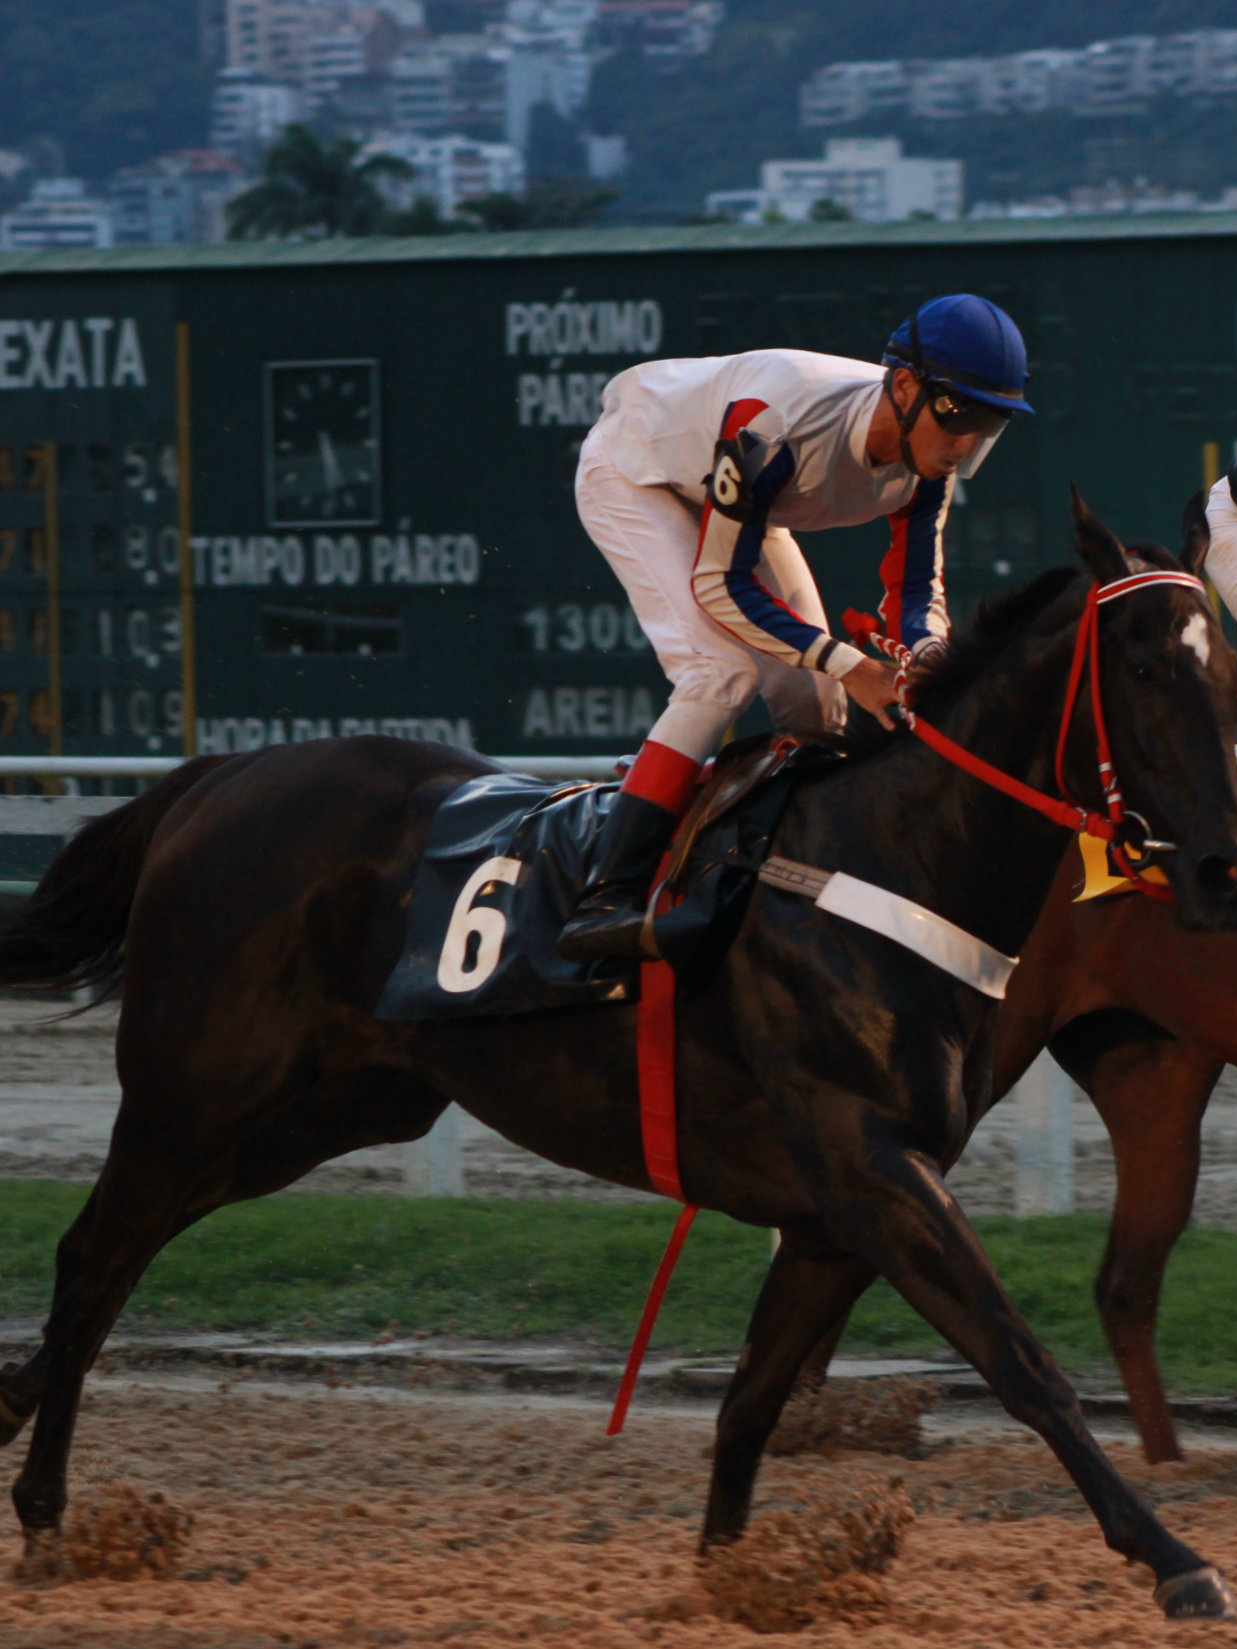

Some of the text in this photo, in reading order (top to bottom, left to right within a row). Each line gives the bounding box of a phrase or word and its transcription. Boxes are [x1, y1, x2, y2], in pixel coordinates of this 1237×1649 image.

[0, 318, 147, 389] EXATA
[506, 287, 662, 356] PRÓXIMO
[518, 358, 612, 427] PÁRE
[713, 455, 741, 505] 6
[189, 516, 480, 586] TEMPO DO PÁREO
[523, 687, 655, 737] AREIA
[437, 856, 522, 993] 6
